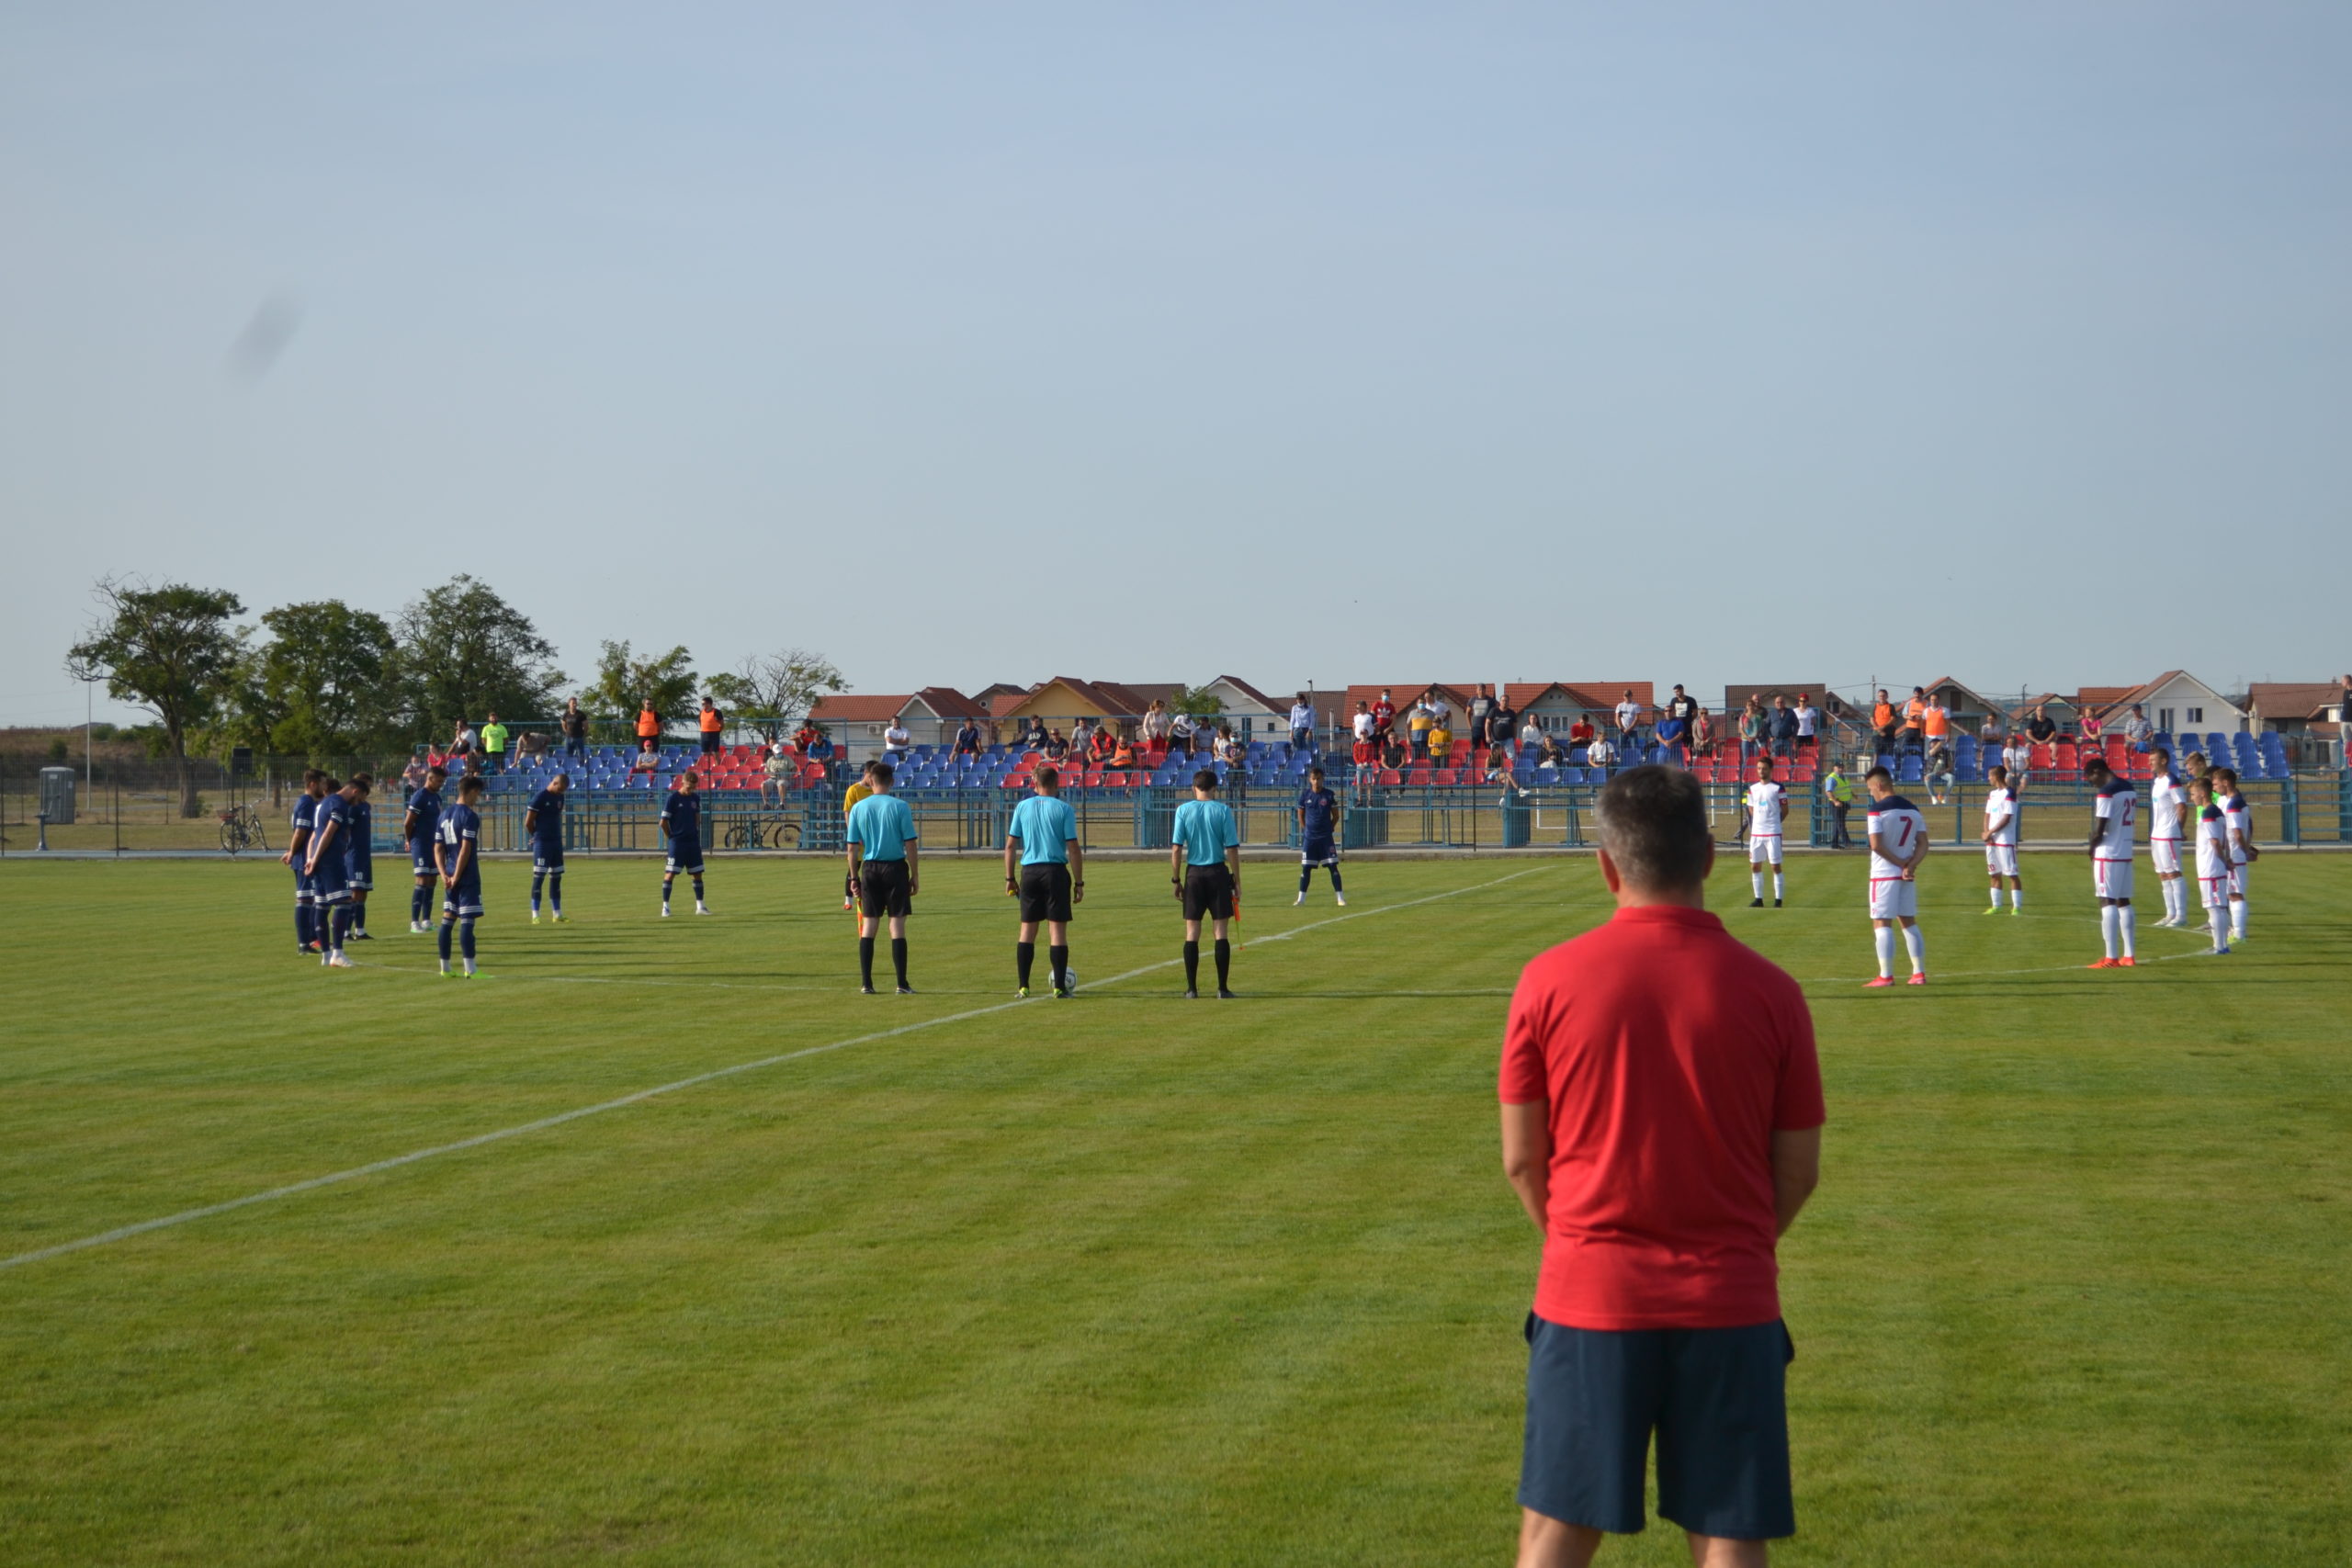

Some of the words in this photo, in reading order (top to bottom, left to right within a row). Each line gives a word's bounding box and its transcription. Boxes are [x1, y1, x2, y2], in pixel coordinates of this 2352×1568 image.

[1898, 816, 1912, 846] 7
[418, 858, 424, 866] 5
[355, 872, 363, 880] 10
